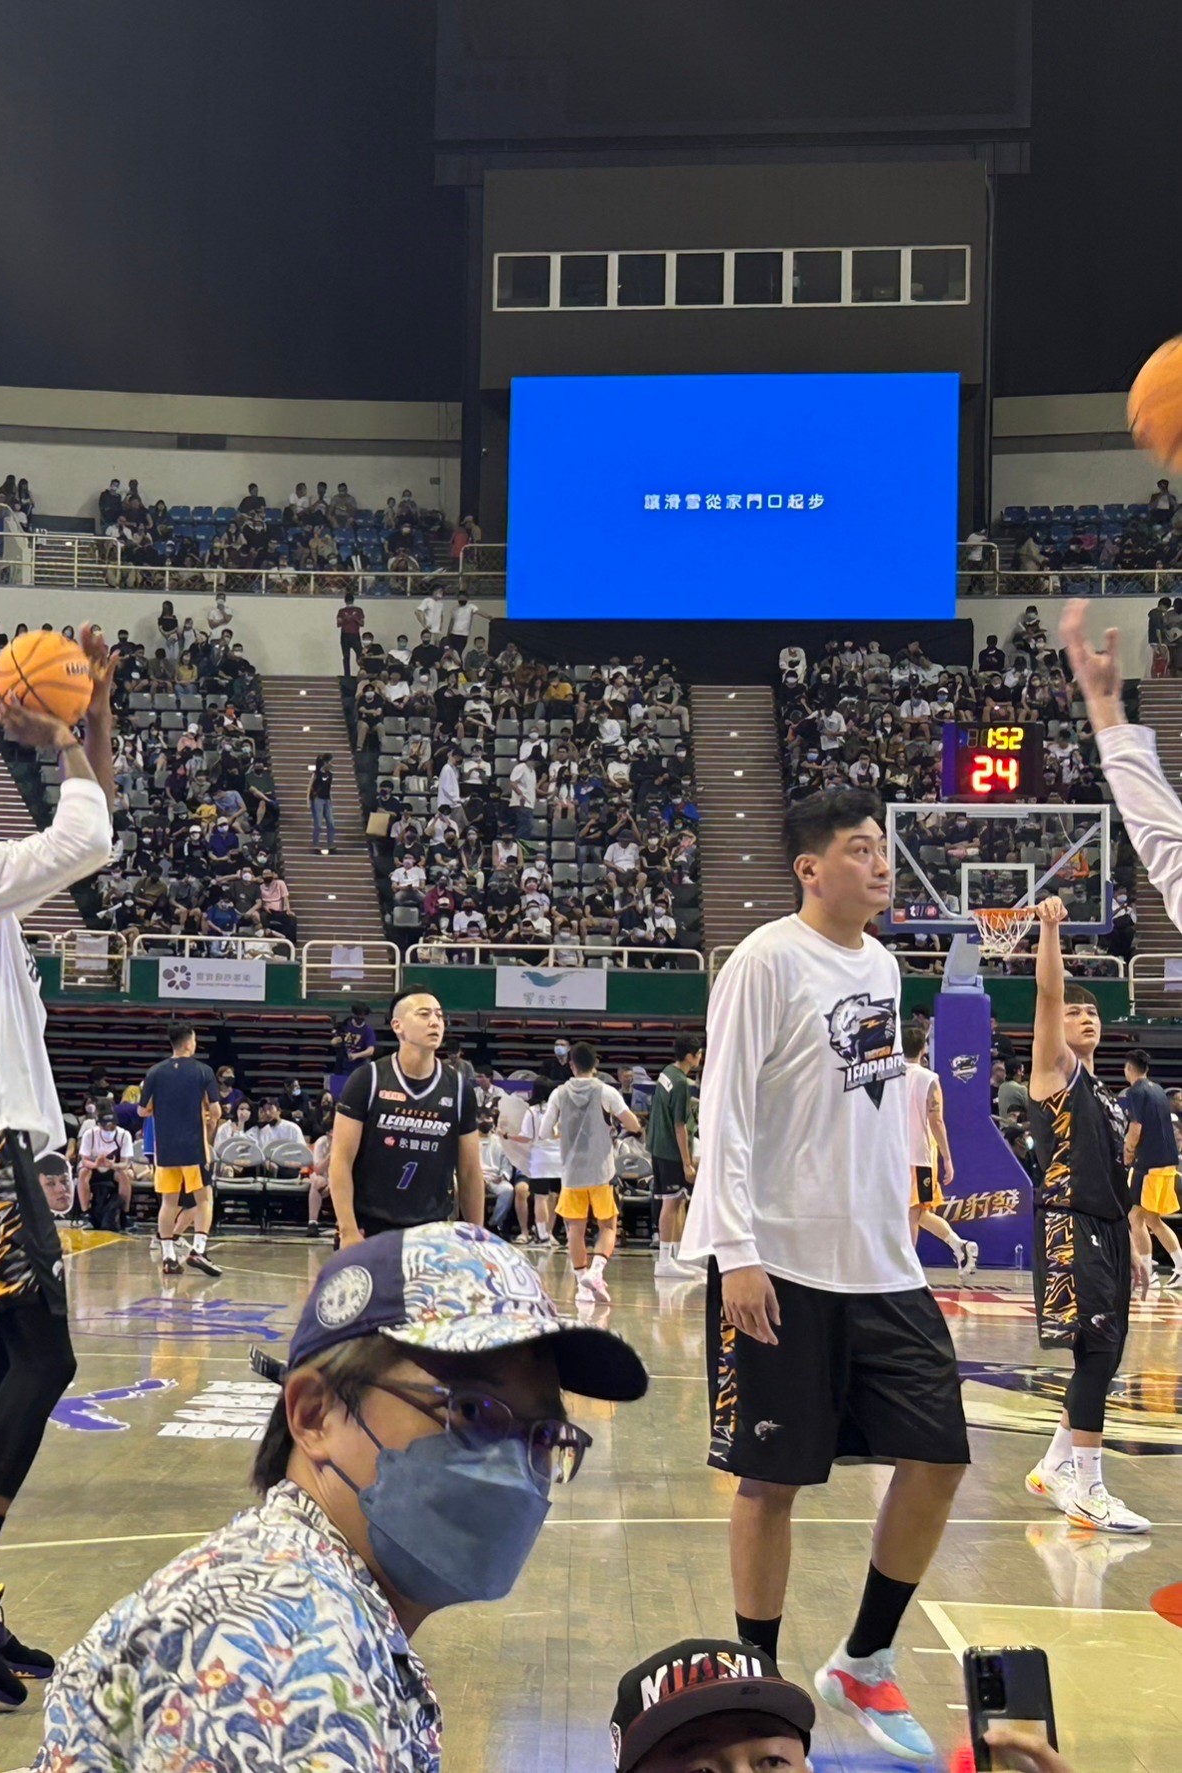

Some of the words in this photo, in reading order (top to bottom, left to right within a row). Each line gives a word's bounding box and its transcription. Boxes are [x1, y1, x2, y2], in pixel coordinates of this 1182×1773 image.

[644, 493, 825, 510] 讓滑雪從家門口起步
[987, 726, 1024, 751] 1:52
[971, 754, 1018, 792] 24
[845, 1053, 906, 1090] LEOPARD
[376, 1113, 451, 1136] LEOPARDS
[396, 1161, 418, 1190] 1
[640, 1651, 763, 1712] MIAMI
